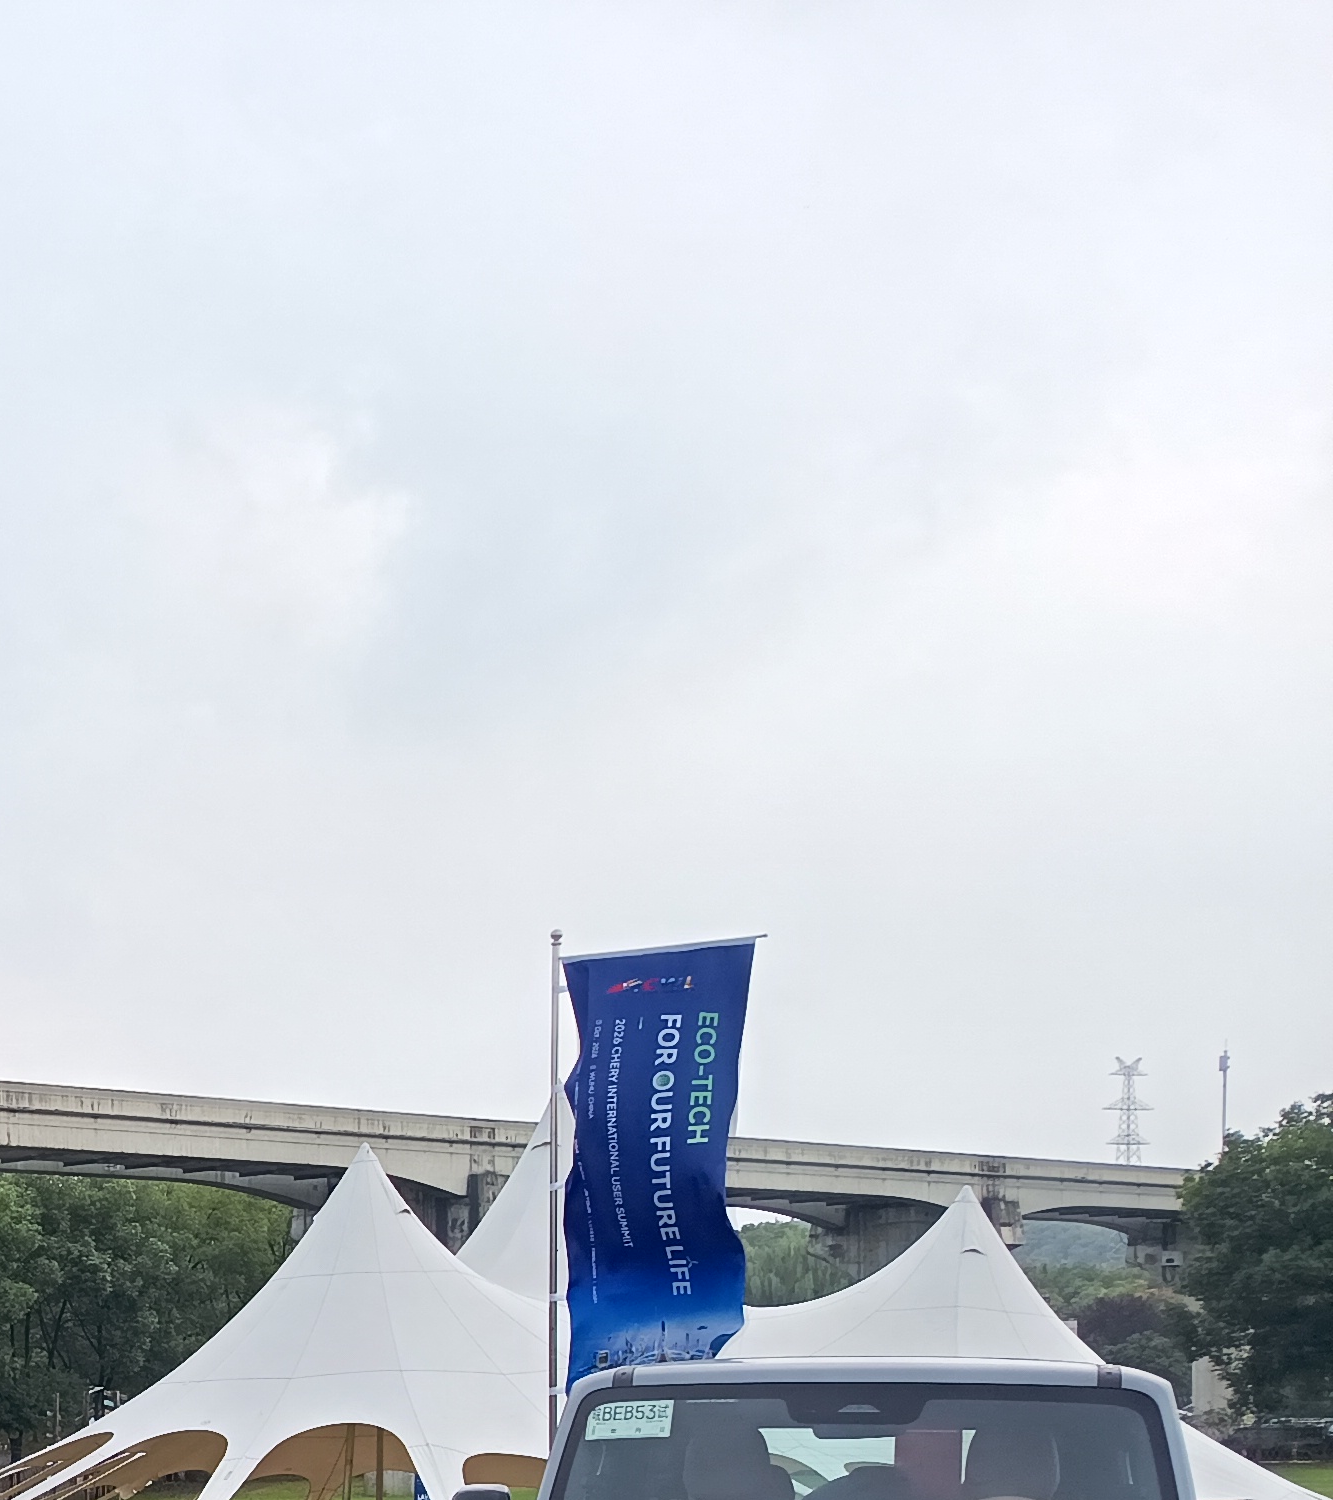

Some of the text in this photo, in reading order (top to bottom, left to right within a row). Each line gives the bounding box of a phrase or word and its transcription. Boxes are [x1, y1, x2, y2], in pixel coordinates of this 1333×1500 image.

[608, 1046, 622, 1083] CHERY
[687, 1011, 719, 1144] ECO-TECH
[606, 1085, 620, 1175] INTERNATIONAL
[649, 1014, 692, 1296] FOR OUR FUTURE LIFE
[611, 1176, 623, 1206] USER
[615, 1207, 634, 1248] SUMMIT
